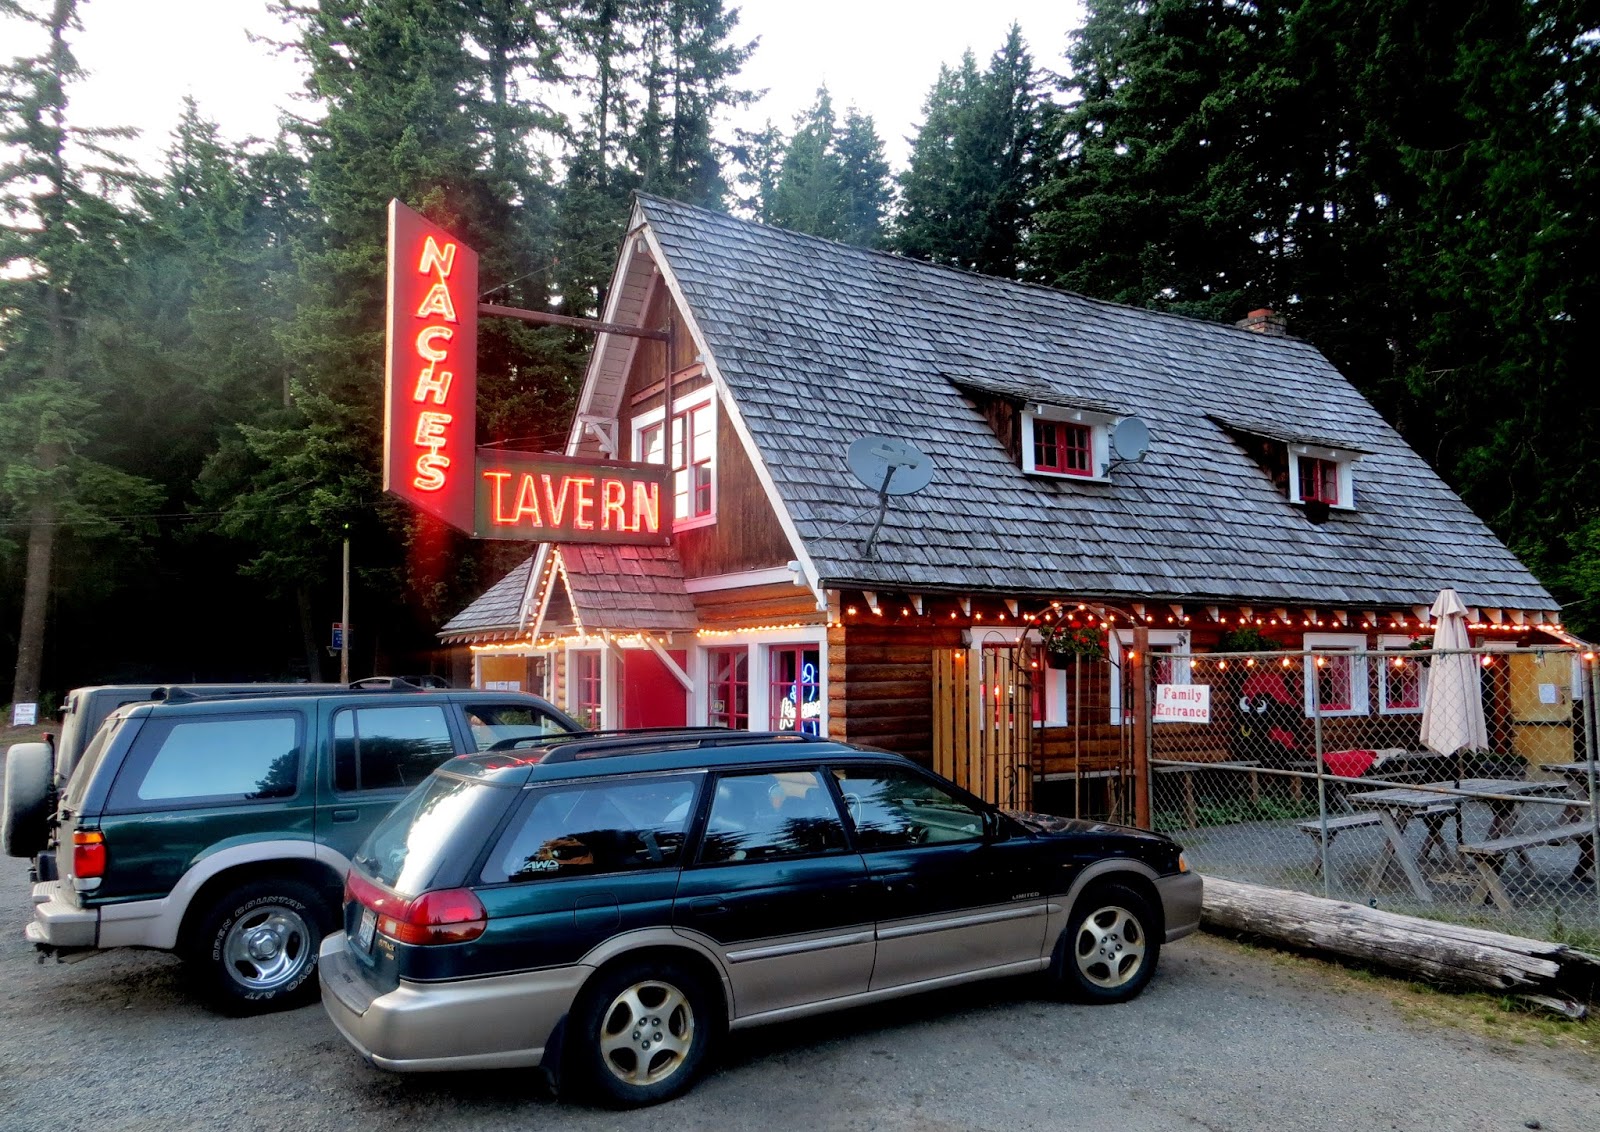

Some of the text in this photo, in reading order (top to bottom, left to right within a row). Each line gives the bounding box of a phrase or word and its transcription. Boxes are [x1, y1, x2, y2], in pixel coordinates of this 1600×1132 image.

[413, 235, 459, 491] NACHES
[483, 471, 659, 533] TAVERN
[1163, 687, 1202, 703] Family
[1156, 703, 1207, 717] Entrance
[522, 860, 559, 870] AWD
[1011, 891, 1040, 900] LIMITED
[213, 896, 306, 961] OPEN COUNTRY
[286, 953, 320, 991] TOYO
